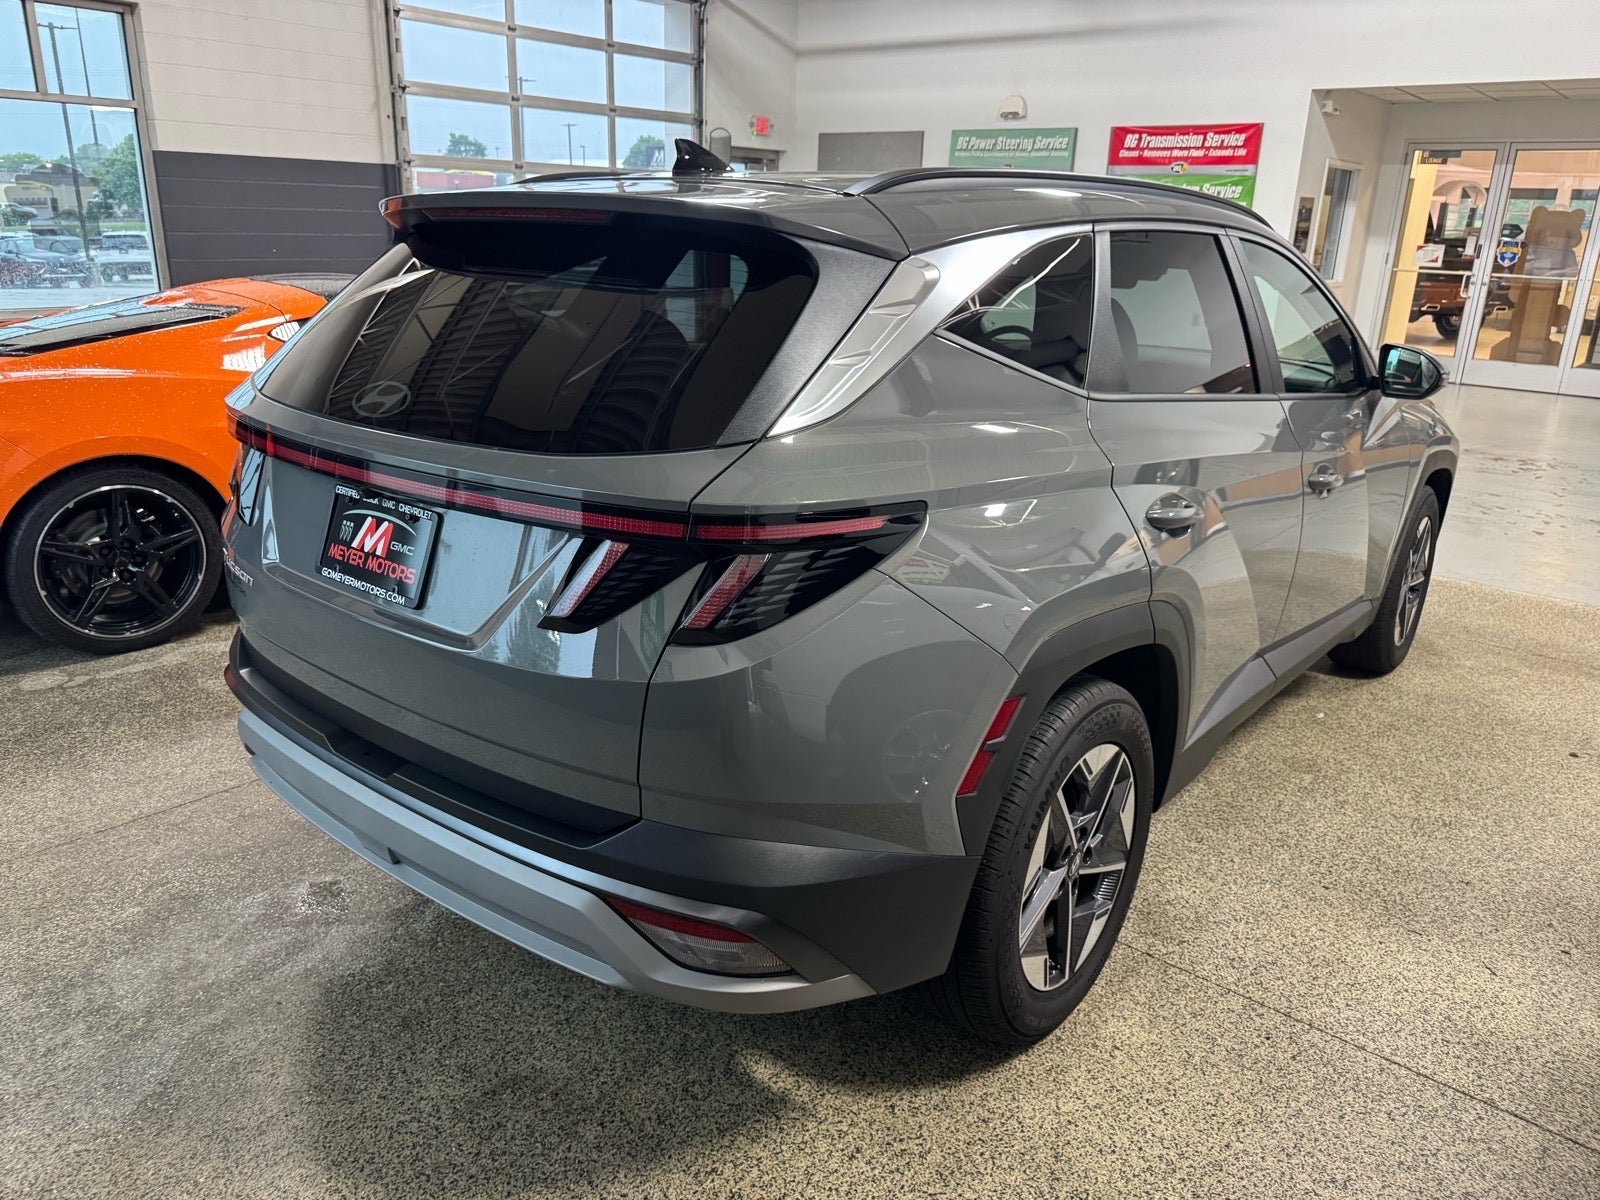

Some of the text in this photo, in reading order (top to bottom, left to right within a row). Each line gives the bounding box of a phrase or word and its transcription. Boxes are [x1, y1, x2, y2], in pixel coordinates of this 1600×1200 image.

[969, 136, 996, 150] Power
[996, 135, 1033, 152] Steering
[1034, 135, 1069, 150] Service
[1124, 131, 1246, 148] BG Transmission Service
[382, 498, 396, 510] GMC
[398, 503, 433, 520] CHEVROLET
[390, 541, 415, 556] GMC
[328, 543, 417, 585] MEYER MOTORS
[321, 567, 406, 606] GOMEYERMOTORS.COM
